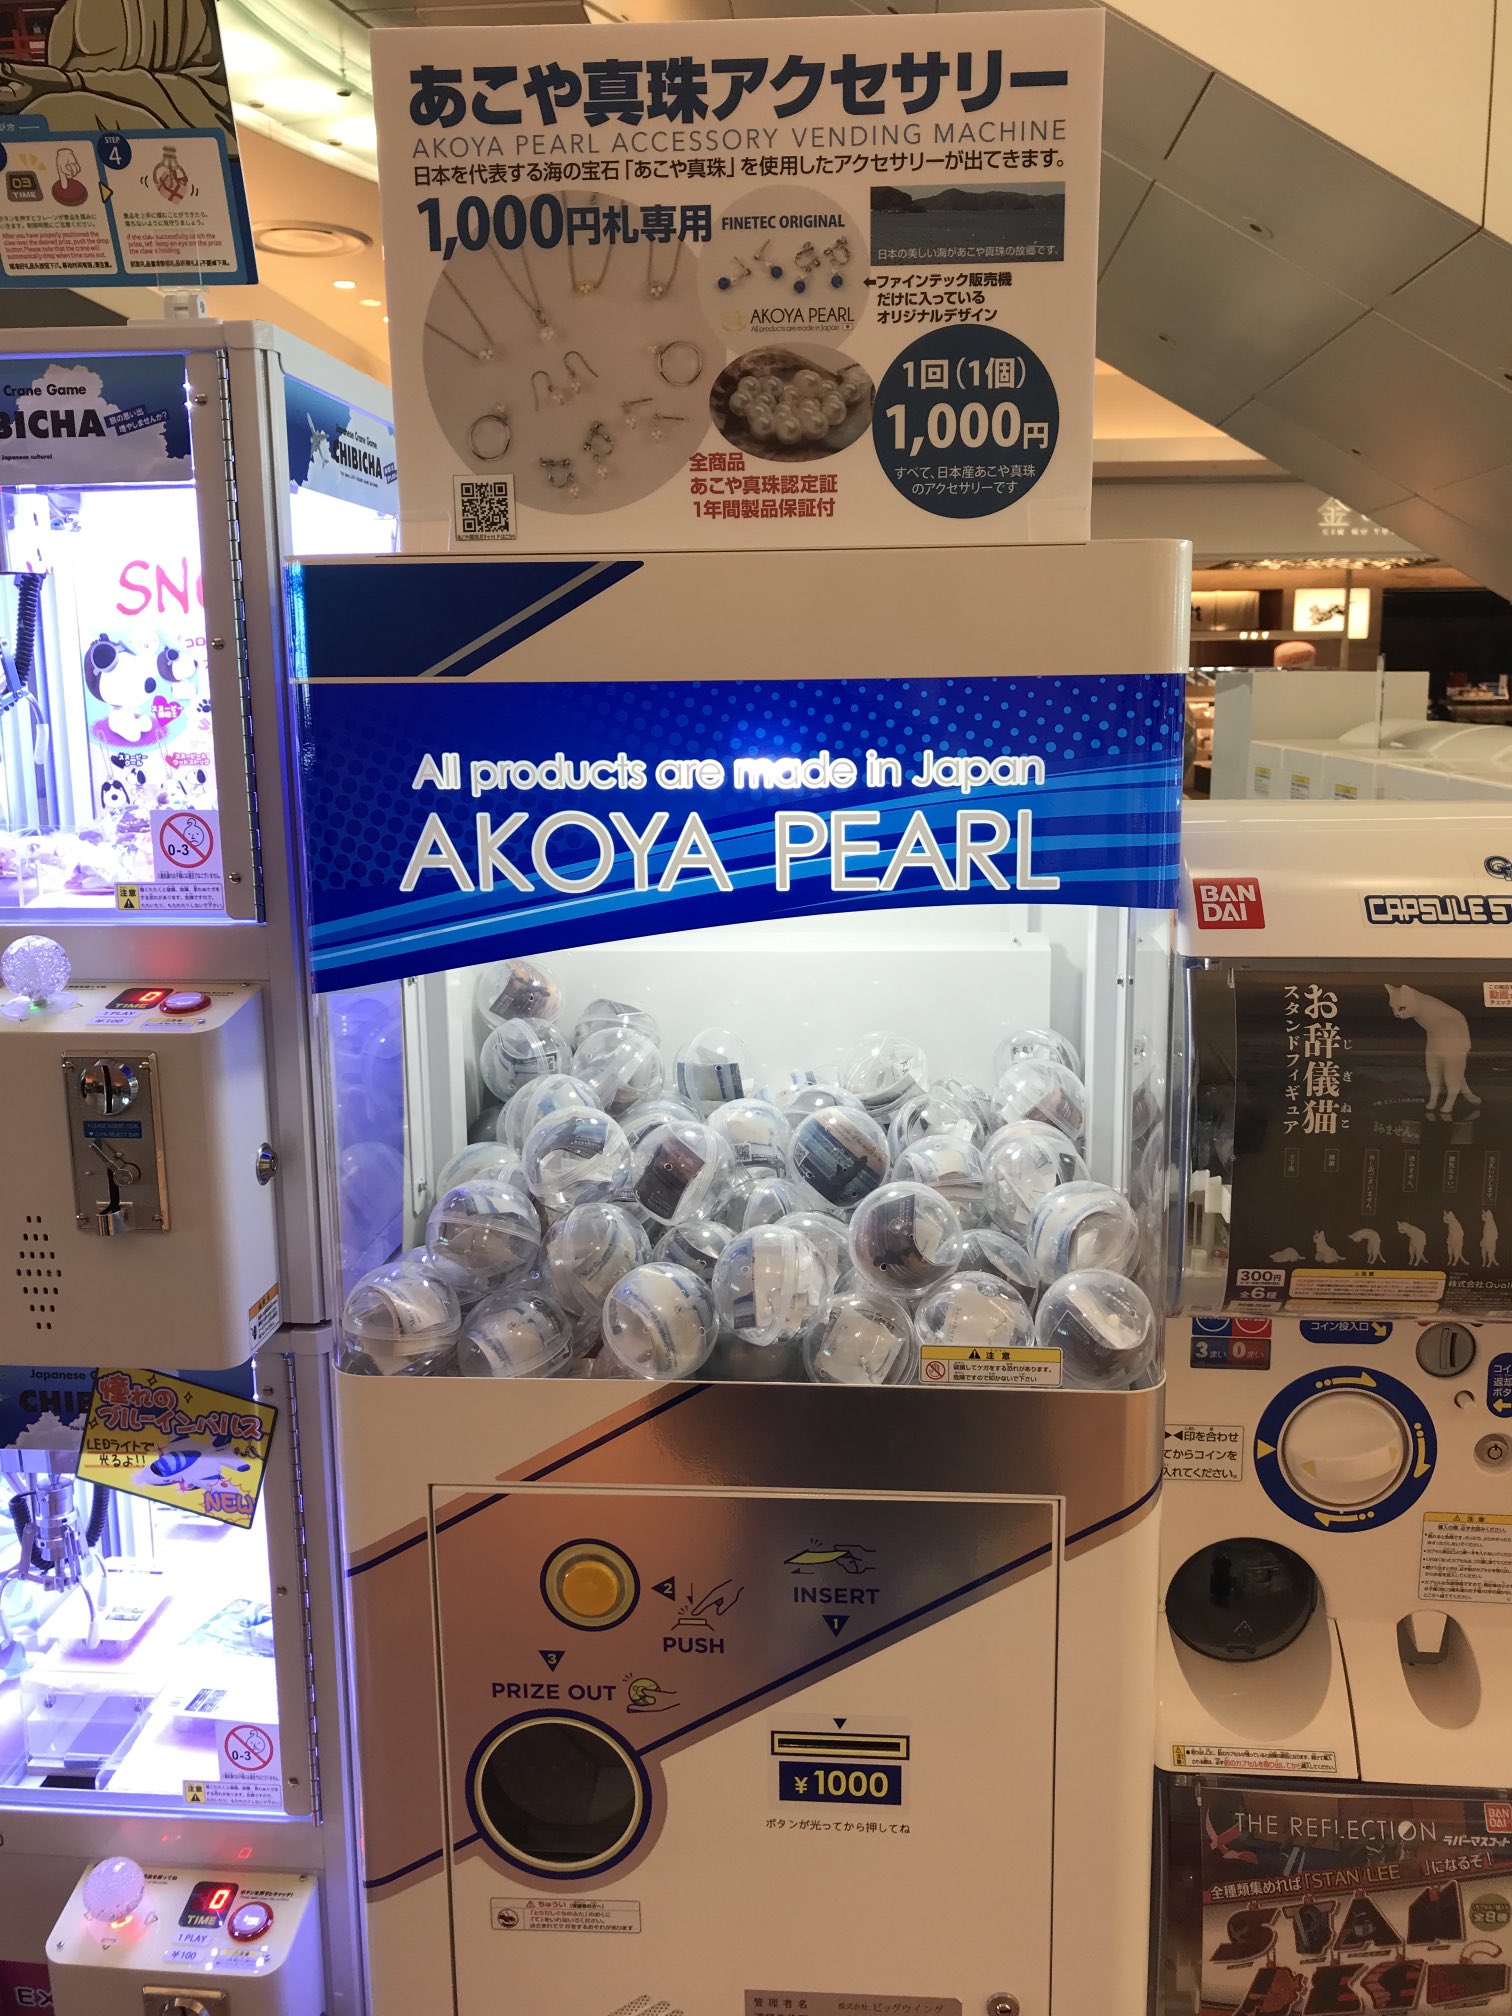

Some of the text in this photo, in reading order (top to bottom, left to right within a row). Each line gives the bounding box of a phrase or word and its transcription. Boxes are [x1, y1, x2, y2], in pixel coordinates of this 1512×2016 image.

[409, 50, 1068, 128] あこや真珠アクセサリー
[104, 136, 121, 144] STEP
[412, 119, 1066, 158] AKOYA PEARL ACCESSORY VENDING MACHINE
[108, 146, 122, 165] 4
[414, 149, 1064, 187] 日本を代表する海の宝石「あこや真珠」を使用したアクセサリーが出てきます。
[417, 193, 712, 260] 1,000円札専用
[722, 214, 846, 230] FINETEC ORIGINAL
[877, 272, 1012, 289] ファインテック販売機
[877, 291, 985, 306] だけに入っている
[751, 307, 855, 324] AKOYA PEARL
[877, 308, 998, 324] オリジナルデザイン
[3, 384, 87, 397] Crane Game
[109, 409, 144, 425] 旅の思い出
[886, 401, 1049, 457] 1,000円
[333, 441, 383, 479] CHIBICHA
[689, 452, 745, 472] 全商品
[895, 464, 1036, 479] すべて、日本産あこや真珠
[690, 474, 838, 495] あこや真珠認定証
[912, 481, 1018, 495] のアクセサリーです
[694, 497, 835, 520] 1年間製品保証付
[117, 557, 204, 615] SN
[411, 749, 1046, 798] All products are made in Japan
[167, 844, 190, 856] 0-3
[399, 809, 1061, 894] AKOYA PEARL
[1199, 884, 1257, 902] BAN
[1202, 902, 1248, 922] DAI
[1283, 985, 1300, 1135] スタンドフィギュア
[1301, 983, 1342, 1135] お辞儀猫
[1241, 1271, 1281, 1281] 300円
[1310, 1321, 1369, 1332] コイン投入口
[986, 1352, 1011, 1360] 注意
[1195, 1341, 1209, 1358] 3
[1232, 1341, 1246, 1358] 0
[30, 1369, 86, 1380] Japanese
[98, 1373, 177, 1410] 憧れの
[98, 1405, 263, 1440] ブルーインパルス
[87, 1437, 155, 1453] LEDライトで
[1184, 1431, 1239, 1442] 印を合わせ
[205, 1491, 255, 1514] NEW
[664, 1583, 673, 1594] 2
[793, 1586, 880, 1605] INSERT
[833, 1618, 840, 1630] 1
[663, 1637, 725, 1654] PUSH
[547, 1653, 557, 1664] 3
[491, 1682, 617, 1702] PRIZE OUT
[232, 1751, 252, 1761] 0-3
[794, 1769, 889, 1798] ¥1000
[1488, 1808, 1510, 1818] BAN
[766, 1818, 911, 1834] ボタンが光ってから押してね
[1235, 1812, 1436, 1841] THE REFLECTION
[1489, 1818, 1507, 1828] DAI
[1367, 1865, 1401, 1883] LEE
[208, 1889, 231, 1910] 0
[187, 1914, 217, 1926] TIME
[185, 1933, 208, 1943] PLAY
[171, 1950, 197, 1960] ¥100
[754, 1998, 808, 2009] 管理者名
